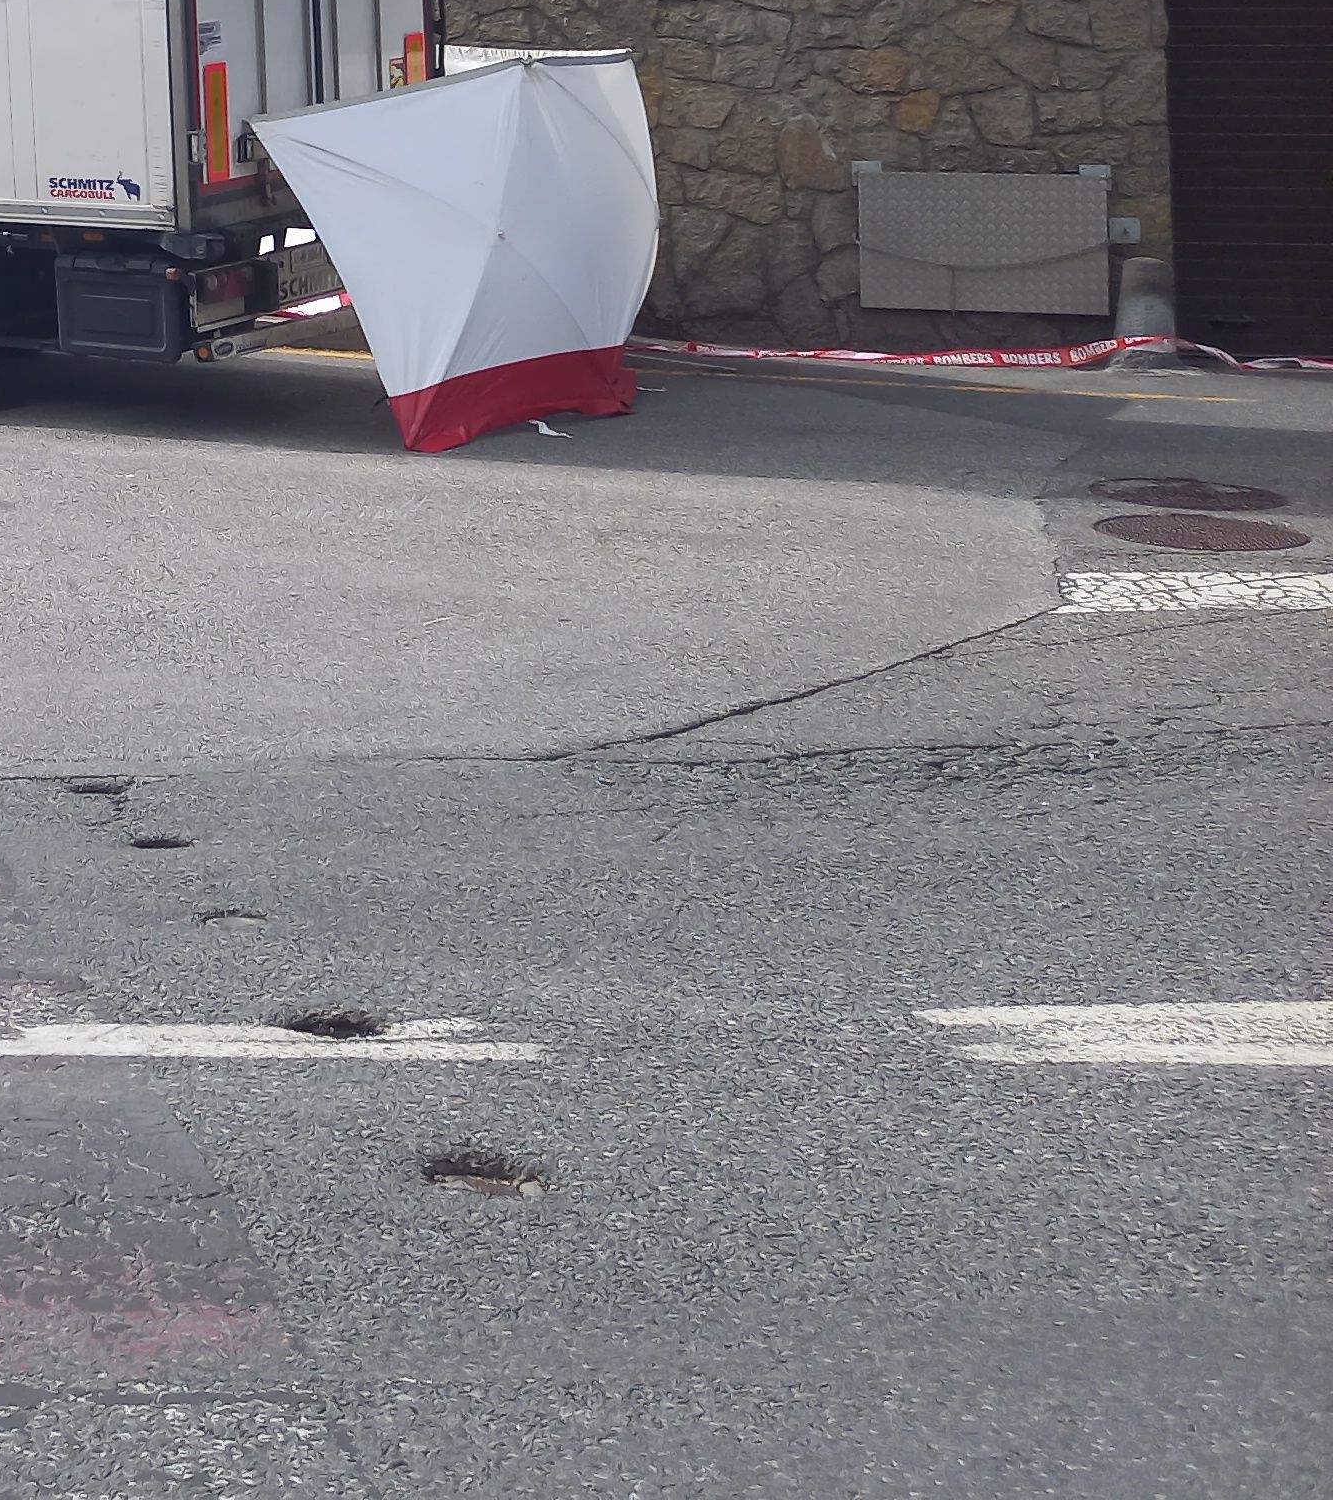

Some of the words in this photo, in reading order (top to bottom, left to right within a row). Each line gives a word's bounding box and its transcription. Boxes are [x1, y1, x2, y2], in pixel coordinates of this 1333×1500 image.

[49, 177, 115, 191] SCHMITZ
[50, 189, 116, 200] CARGOBULL
[933, 352, 994, 365] BOMBERS
[1000, 351, 1062, 365] BOMBERS
